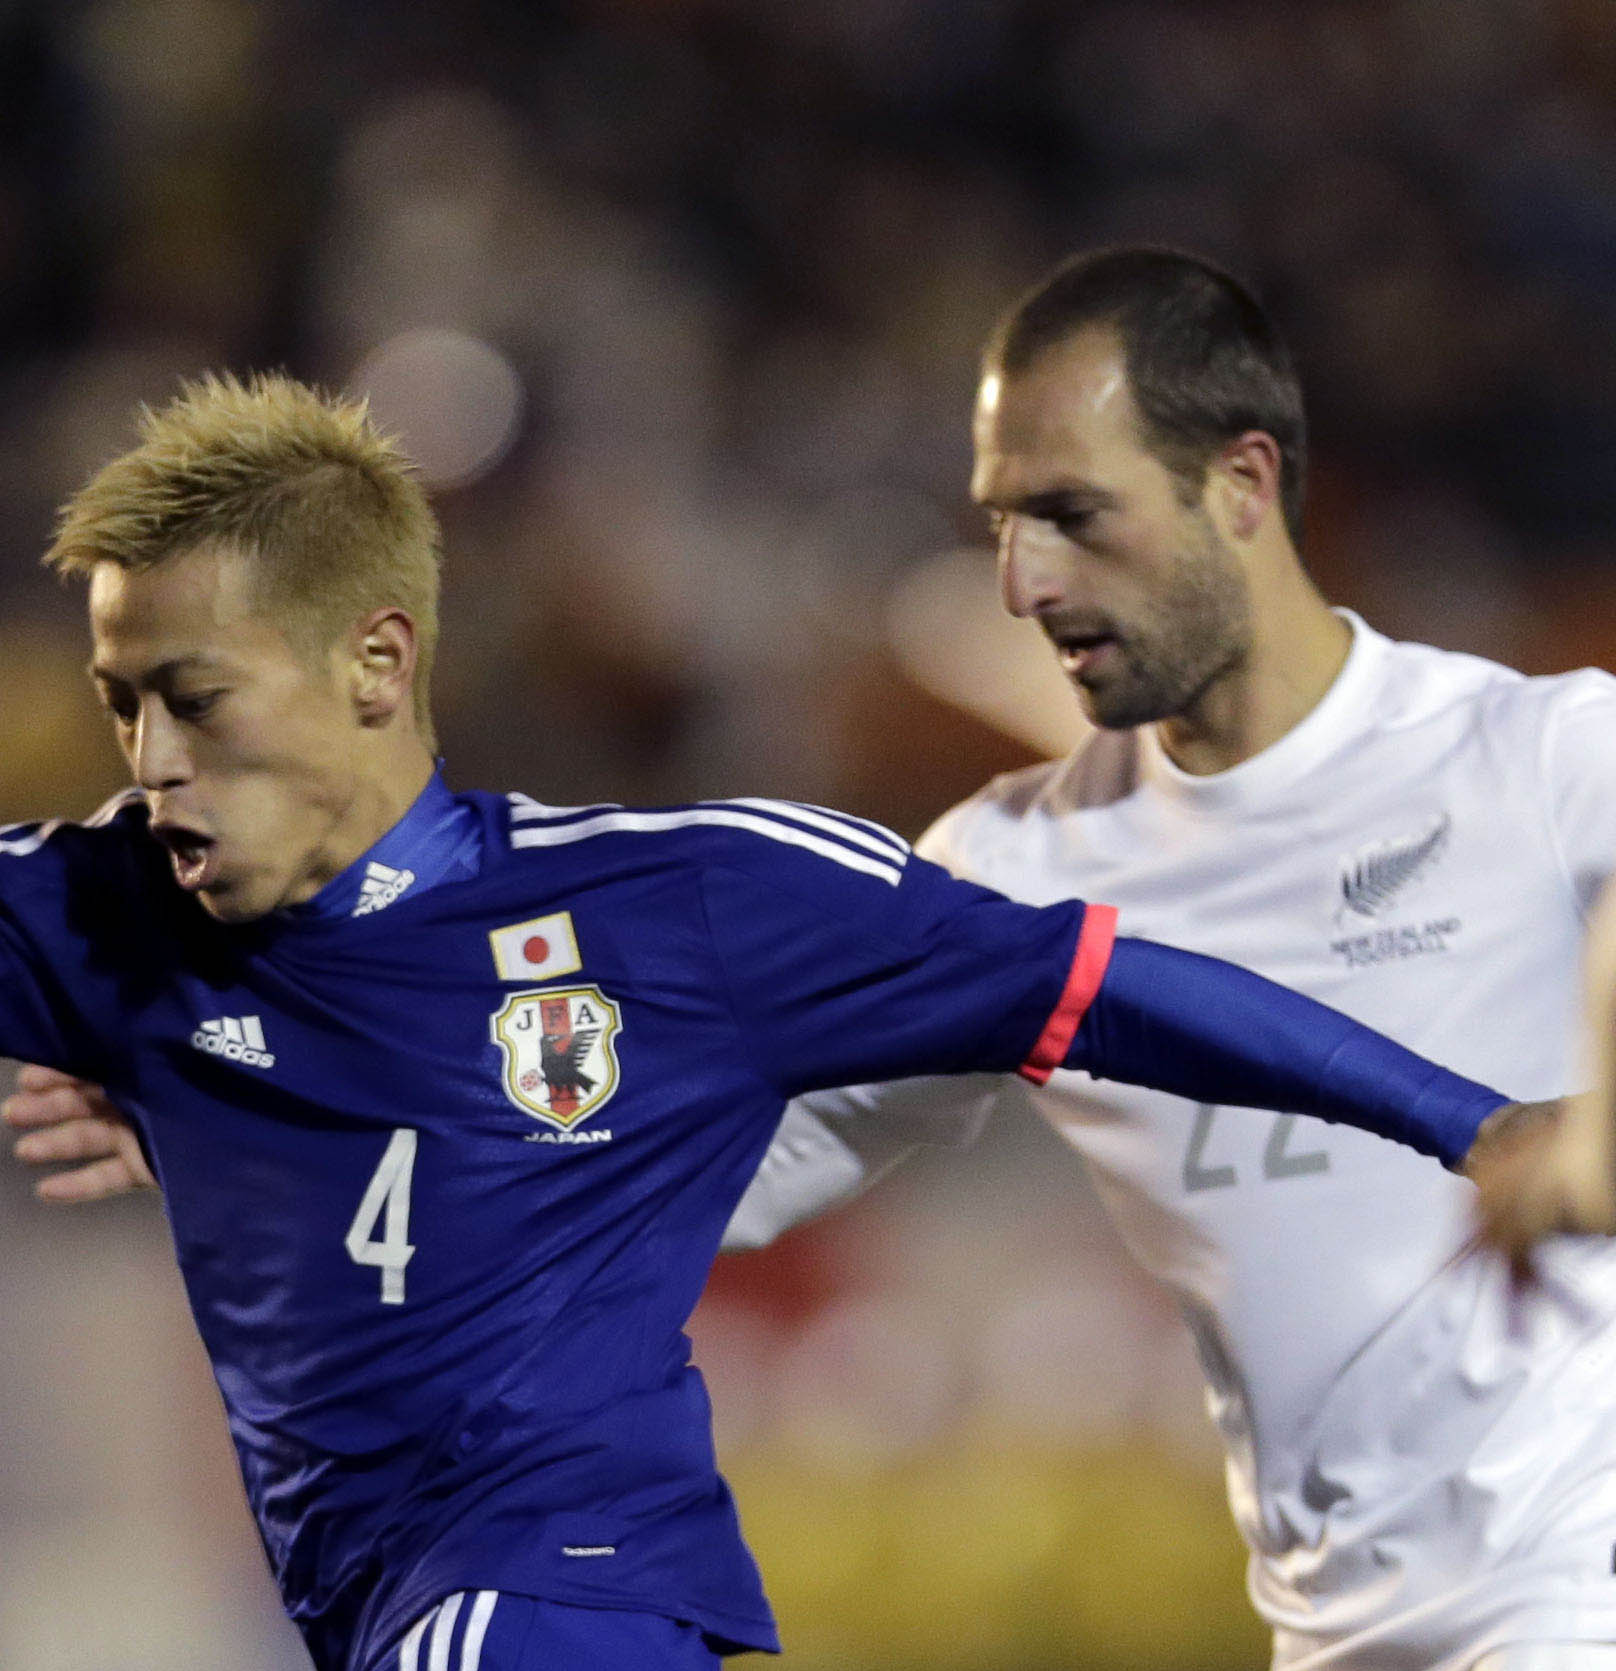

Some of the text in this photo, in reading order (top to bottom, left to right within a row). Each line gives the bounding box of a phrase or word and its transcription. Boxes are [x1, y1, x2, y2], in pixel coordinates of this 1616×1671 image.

[190, 1030, 276, 1069] adidas
[521, 1128, 613, 1144] JAPAN
[345, 1127, 418, 1305] 4
